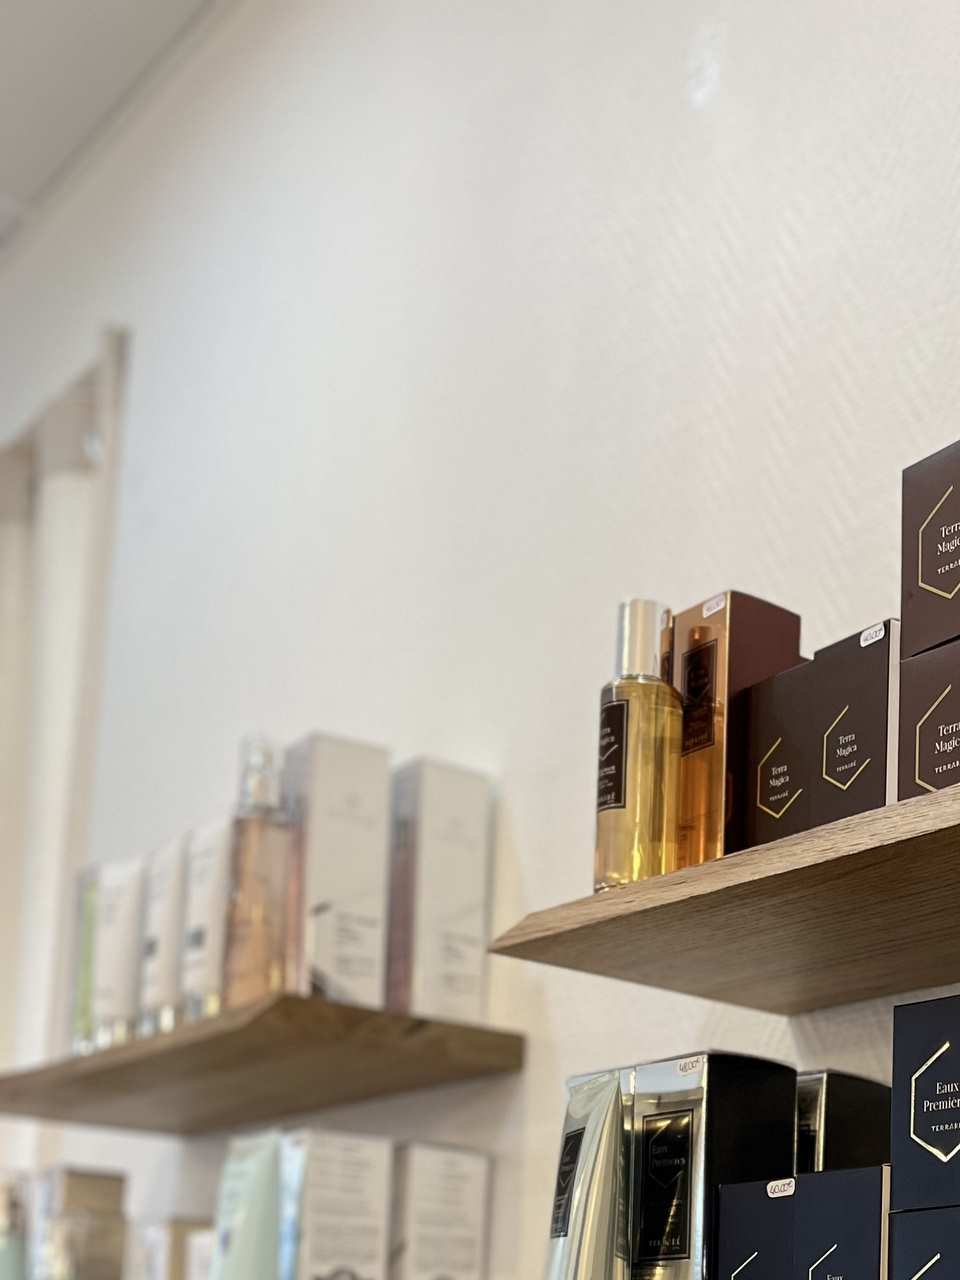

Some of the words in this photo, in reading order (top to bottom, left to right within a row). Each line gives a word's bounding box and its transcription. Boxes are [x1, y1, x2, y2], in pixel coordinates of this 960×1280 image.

[838, 733, 855, 745] Terra
[836, 744, 857, 758] Magica
[771, 764, 787, 775] Terra
[936, 1082, 959, 1096] Eaux
